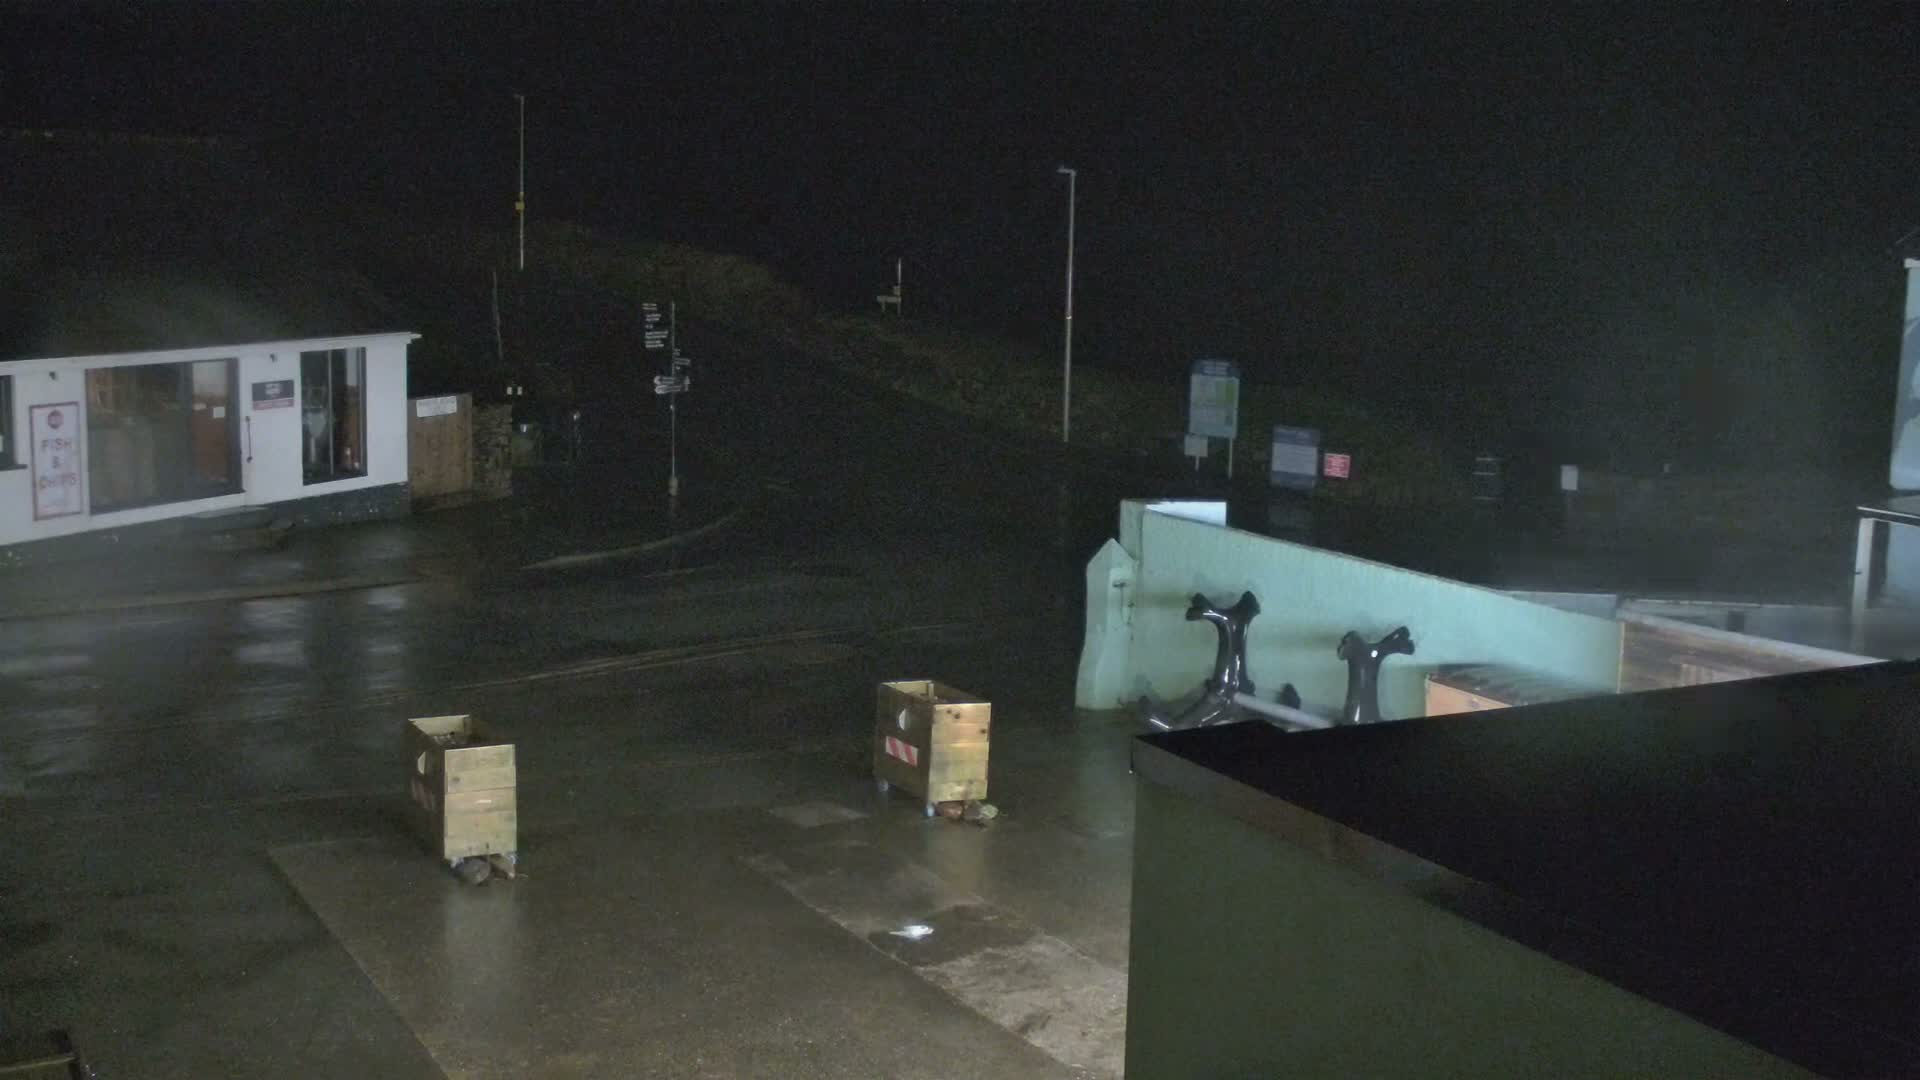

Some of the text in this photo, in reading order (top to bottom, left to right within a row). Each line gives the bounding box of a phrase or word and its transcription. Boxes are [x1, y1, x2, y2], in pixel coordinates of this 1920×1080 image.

[41, 438, 73, 452] FISH
[52, 456, 60, 469] &
[38, 473, 77, 490] CHIPS
